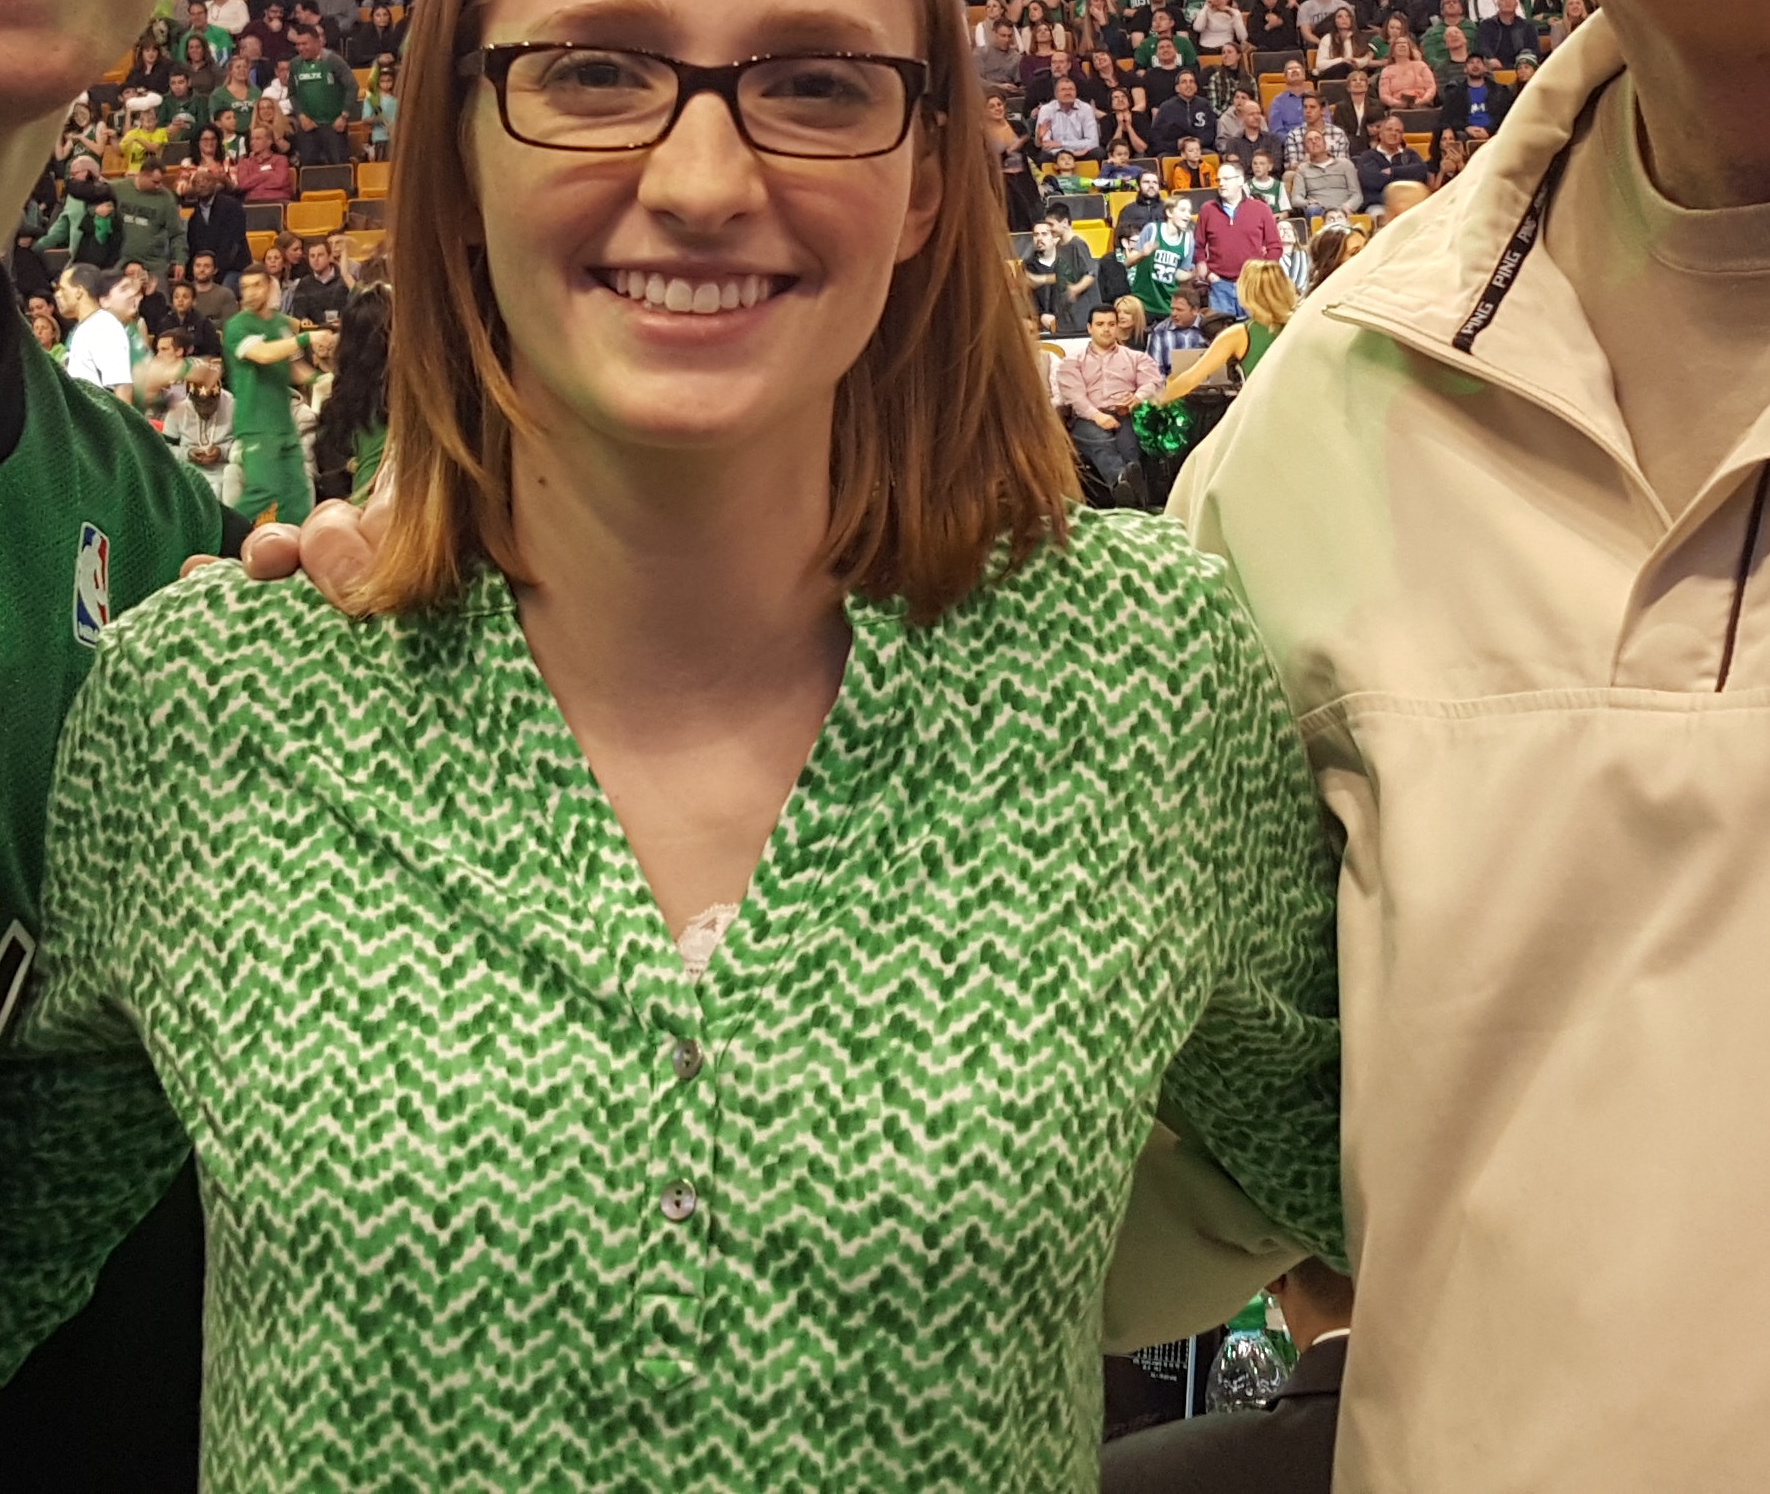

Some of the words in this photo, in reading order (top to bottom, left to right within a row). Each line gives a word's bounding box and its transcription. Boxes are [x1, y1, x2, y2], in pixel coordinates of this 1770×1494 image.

[1151, 263, 1176, 284] 33
[1461, 302, 1494, 334] PING
[1492, 250, 1522, 289] PING
